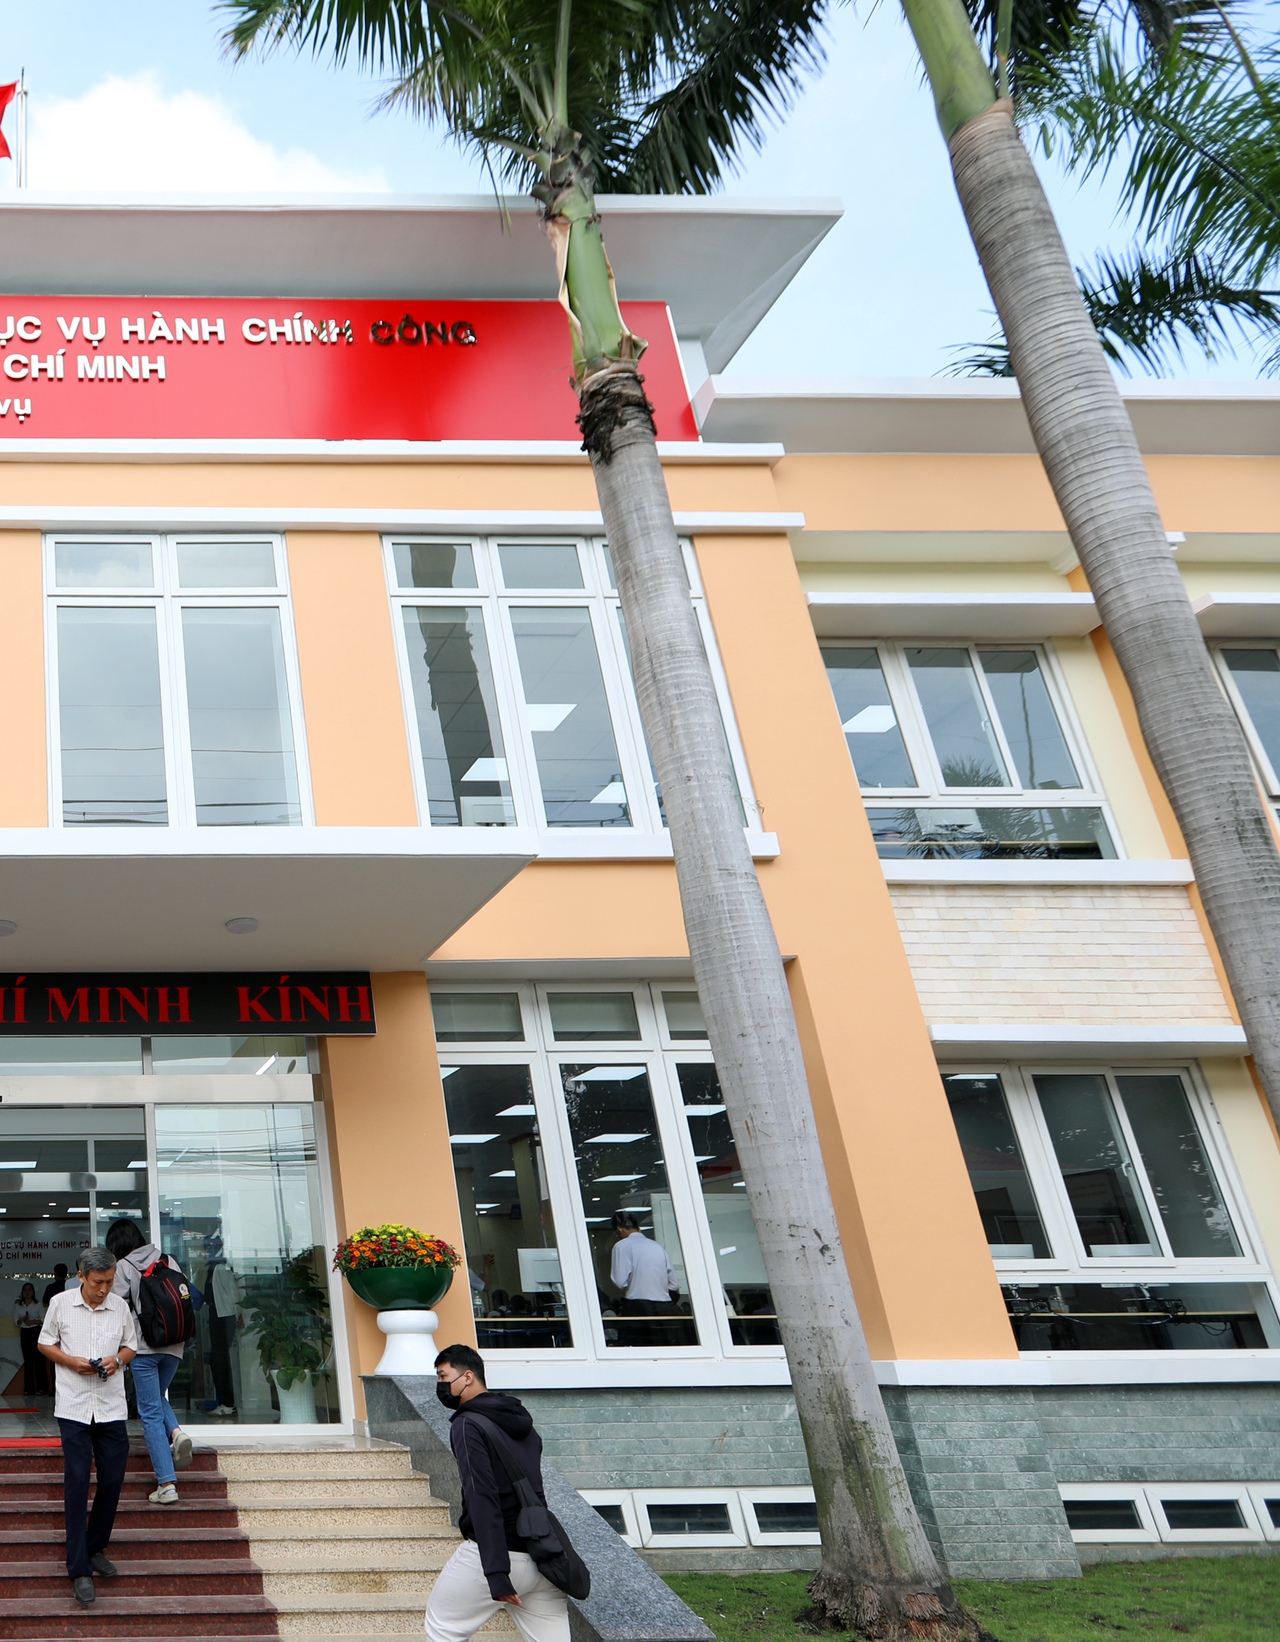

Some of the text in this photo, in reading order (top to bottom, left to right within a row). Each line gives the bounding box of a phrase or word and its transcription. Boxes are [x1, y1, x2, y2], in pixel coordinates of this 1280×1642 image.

[56, 316, 107, 347] VỤ
[121, 310, 226, 342] HÀNH
[241, 311, 354, 344] CHÍNH
[370, 313, 478, 345] CÔNG
[3, 350, 66, 379] CHÍ
[76, 354, 166, 381] MINH
[46, 987, 192, 1023] MINH
[235, 975, 375, 1022] KÍNH
[27, 1240, 49, 1249] HÀNH
[79, 1240, 90, 1249] CÔ
